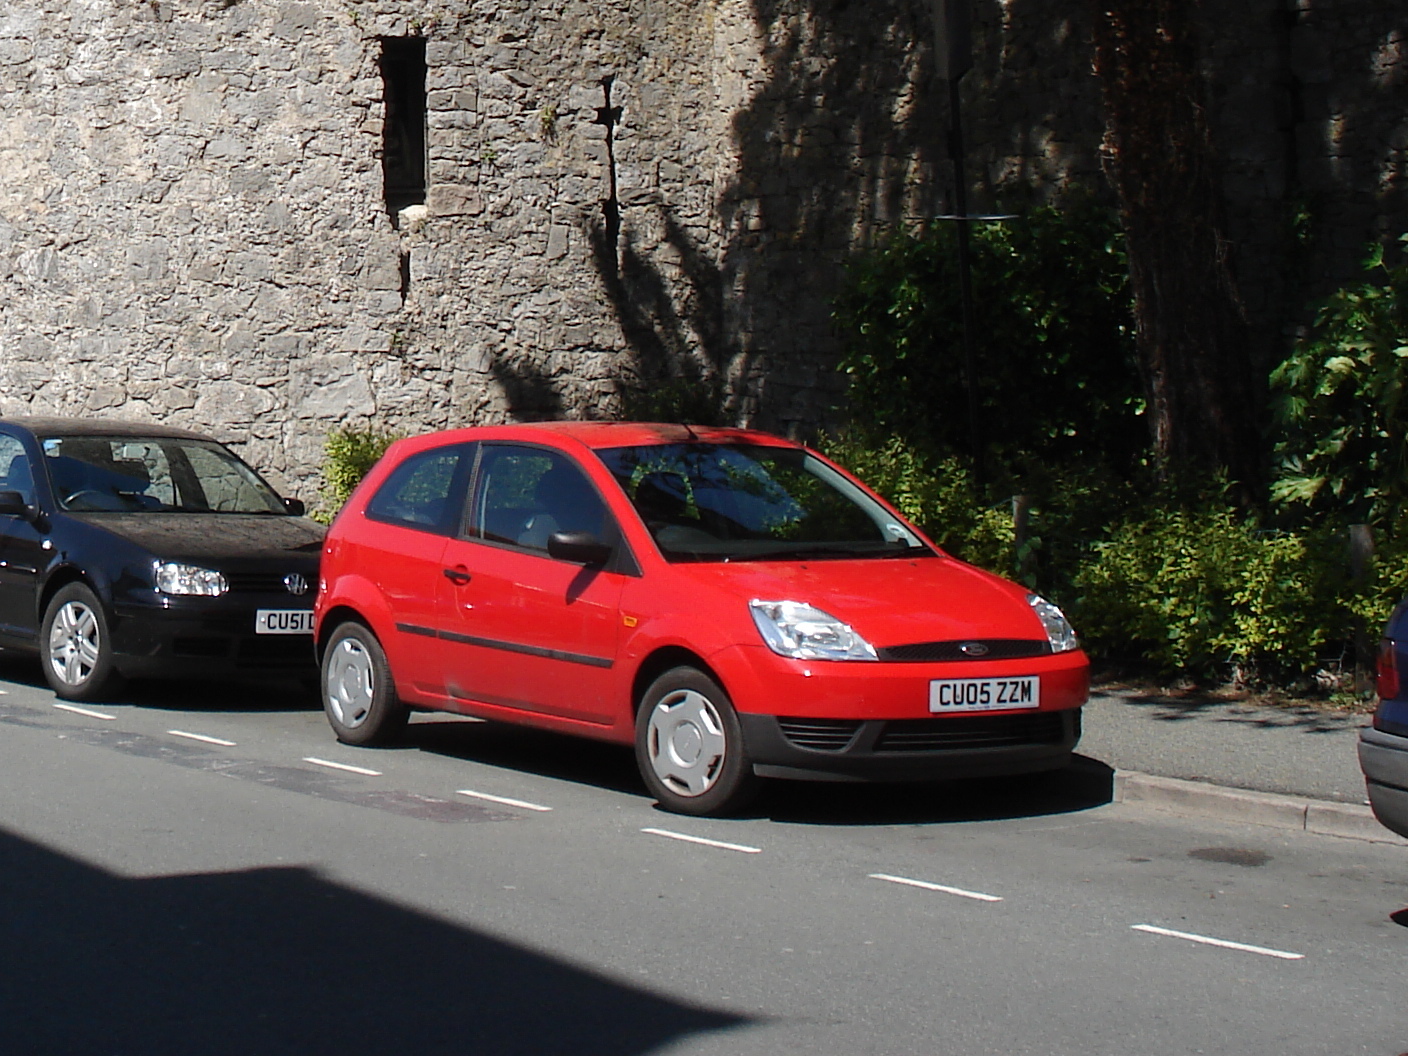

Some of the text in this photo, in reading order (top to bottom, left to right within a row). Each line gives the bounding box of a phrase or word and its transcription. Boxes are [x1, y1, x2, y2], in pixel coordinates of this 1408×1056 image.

[267, 613, 304, 630] CU51
[939, 680, 1032, 706] CU05 ZZM
